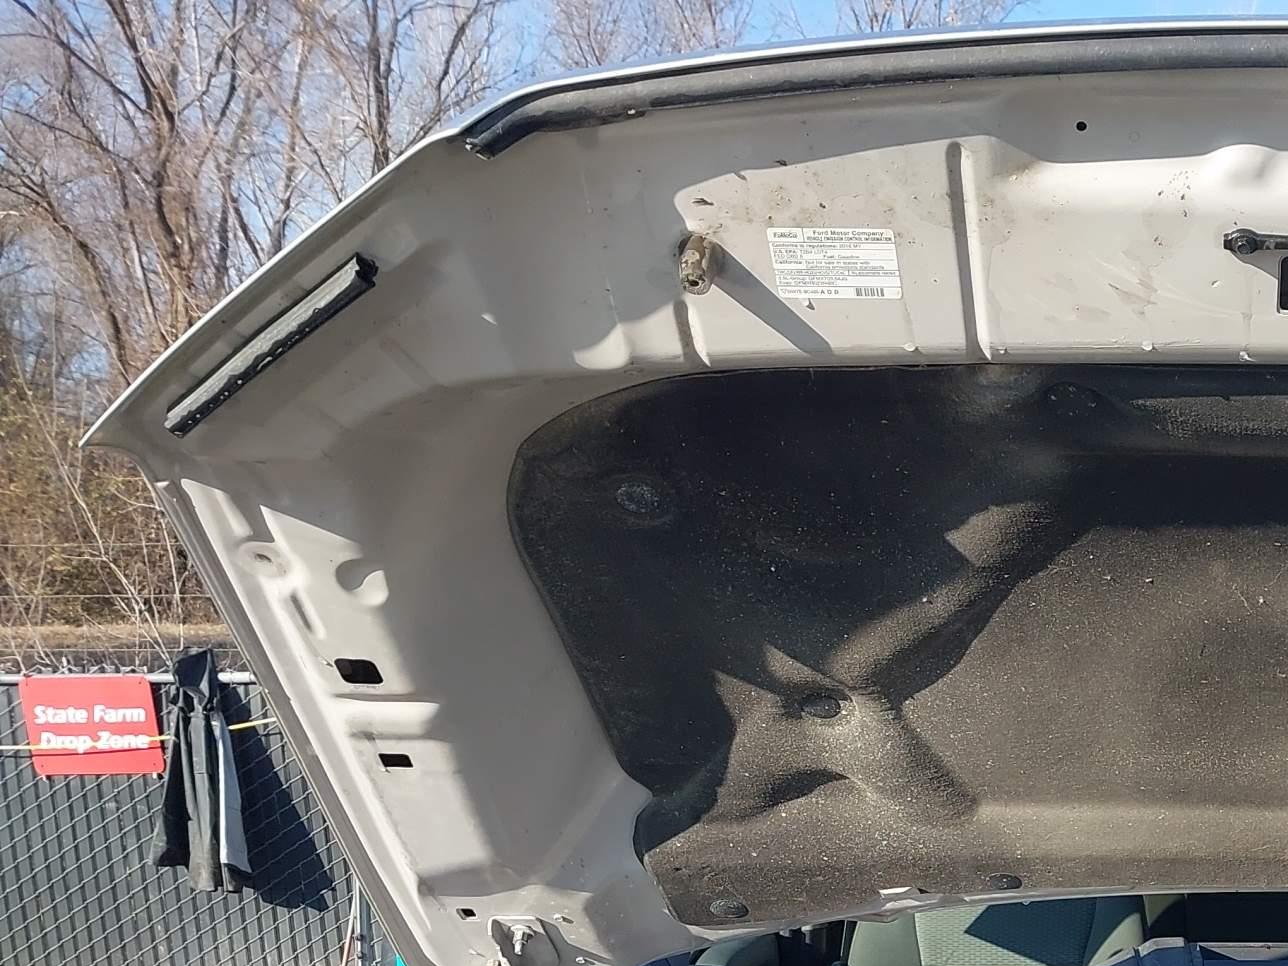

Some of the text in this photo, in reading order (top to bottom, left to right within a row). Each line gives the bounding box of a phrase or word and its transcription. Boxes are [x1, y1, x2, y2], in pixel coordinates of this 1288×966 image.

[33, 704, 146, 724] State Farm
[40, 731, 150, 754] Drop Zone
